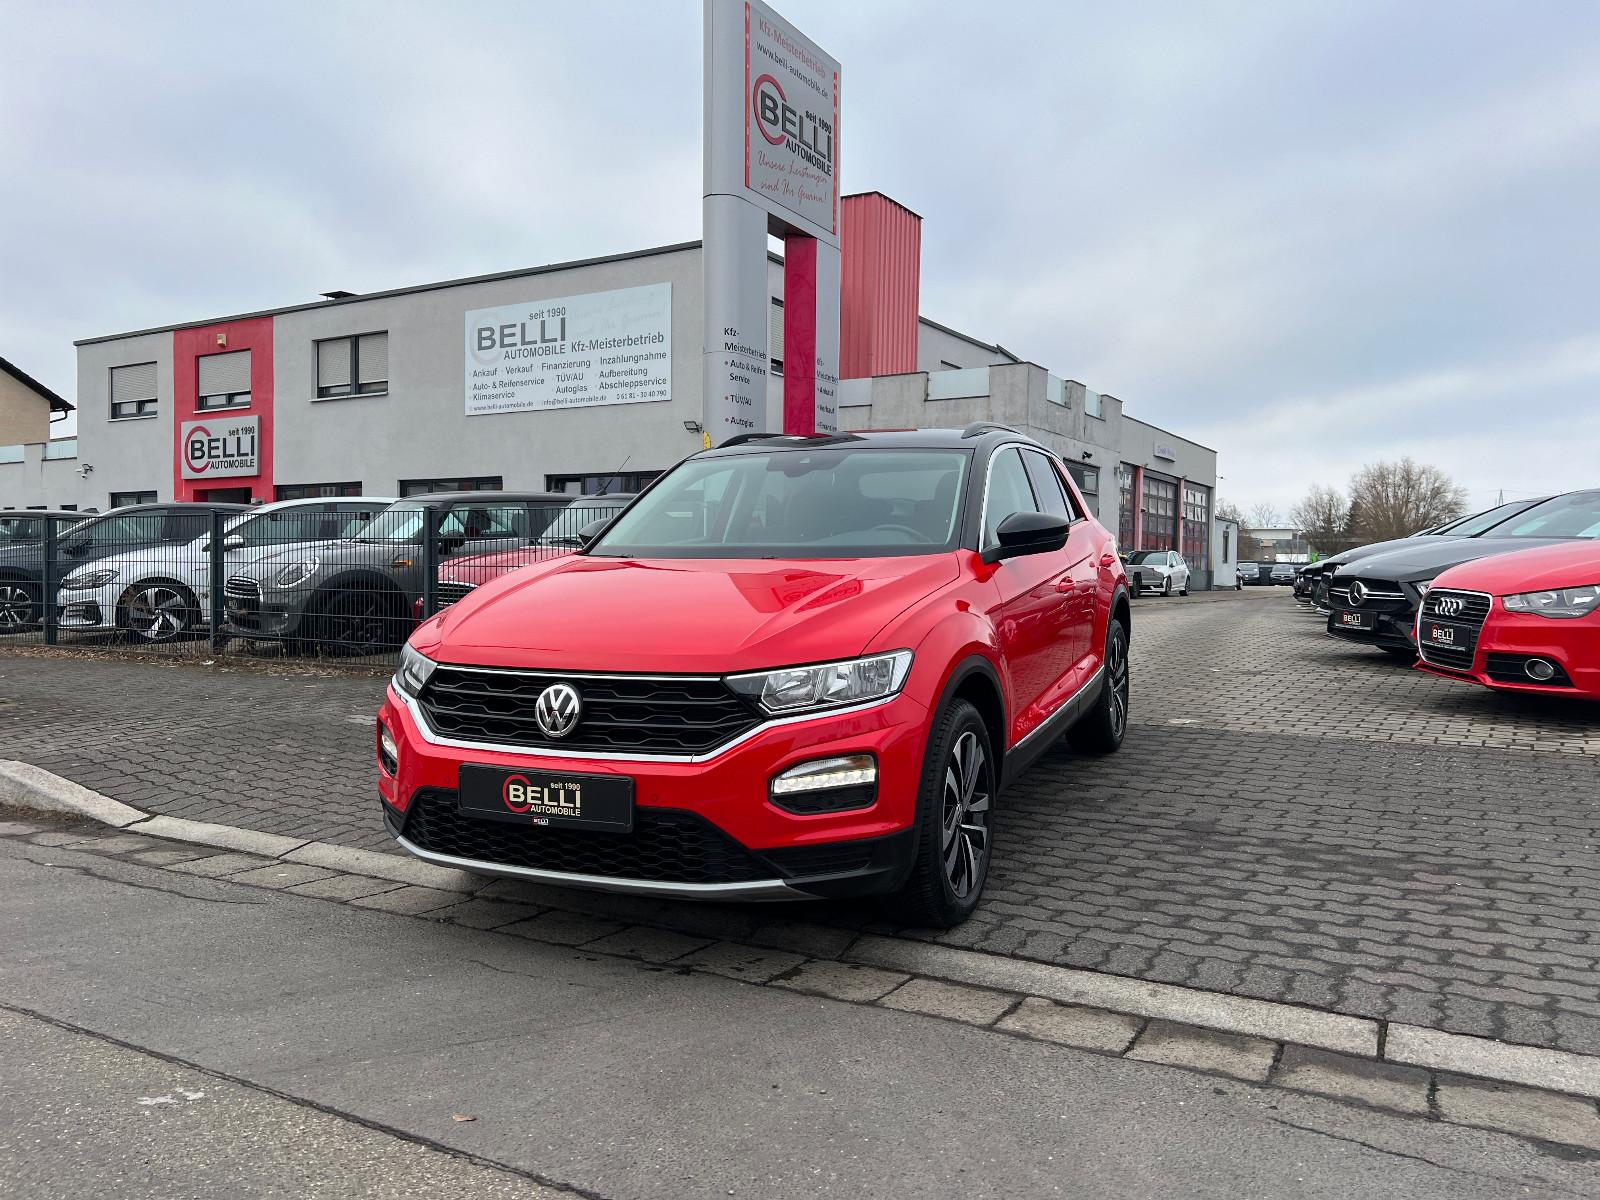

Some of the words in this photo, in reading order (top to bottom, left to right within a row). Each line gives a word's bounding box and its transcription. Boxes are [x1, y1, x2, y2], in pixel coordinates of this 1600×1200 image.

[759, 18, 826, 78] Kfz-Meisterbetrieb
[756, 41, 829, 99] www.belli-automobile.de
[760, 89, 832, 163] BELLI
[805, 109, 817, 125] seit
[818, 115, 832, 134] 1990
[785, 138, 832, 177] AUTOMOBILE
[529, 310, 545, 321] seit
[546, 306, 566, 318] 1990
[477, 317, 566, 351] BELLI
[724, 327, 740, 337] Kfz-
[571, 332, 665, 353] Kfz-Meisterbetrieb
[504, 344, 566, 360] AUTOMOBILE
[725, 342, 767, 359] Meisterbetrieb
[473, 368, 498, 378] Ankauf
[506, 364, 534, 375] Verkauf
[542, 360, 591, 371] Finanzierung
[600, 352, 667, 366] Inzahlungnahme
[730, 360, 745, 370] Auto
[556, 372, 584, 383] TÜV/AU
[599, 367, 648, 379] Aufbereitung
[730, 373, 750, 384] Service
[473, 382, 491, 391] Auto-
[499, 378, 545, 389] Reifenservice
[556, 385, 588, 395] Autoglas
[599, 377, 667, 391] Abschleppservice
[473, 391, 515, 401] Klimaservice
[229, 428, 240, 437] seit
[241, 426, 255, 435] 1990
[190, 435, 255, 460] BELLI
[210, 459, 255, 470] AUTOMOBILE
[1433, 629, 1454, 640] BELLI
[550, 782, 563, 790] seit
[564, 782, 581, 791] 1990
[509, 784, 581, 808] BELLI
[530, 804, 581, 817] AUTOMOBILE
